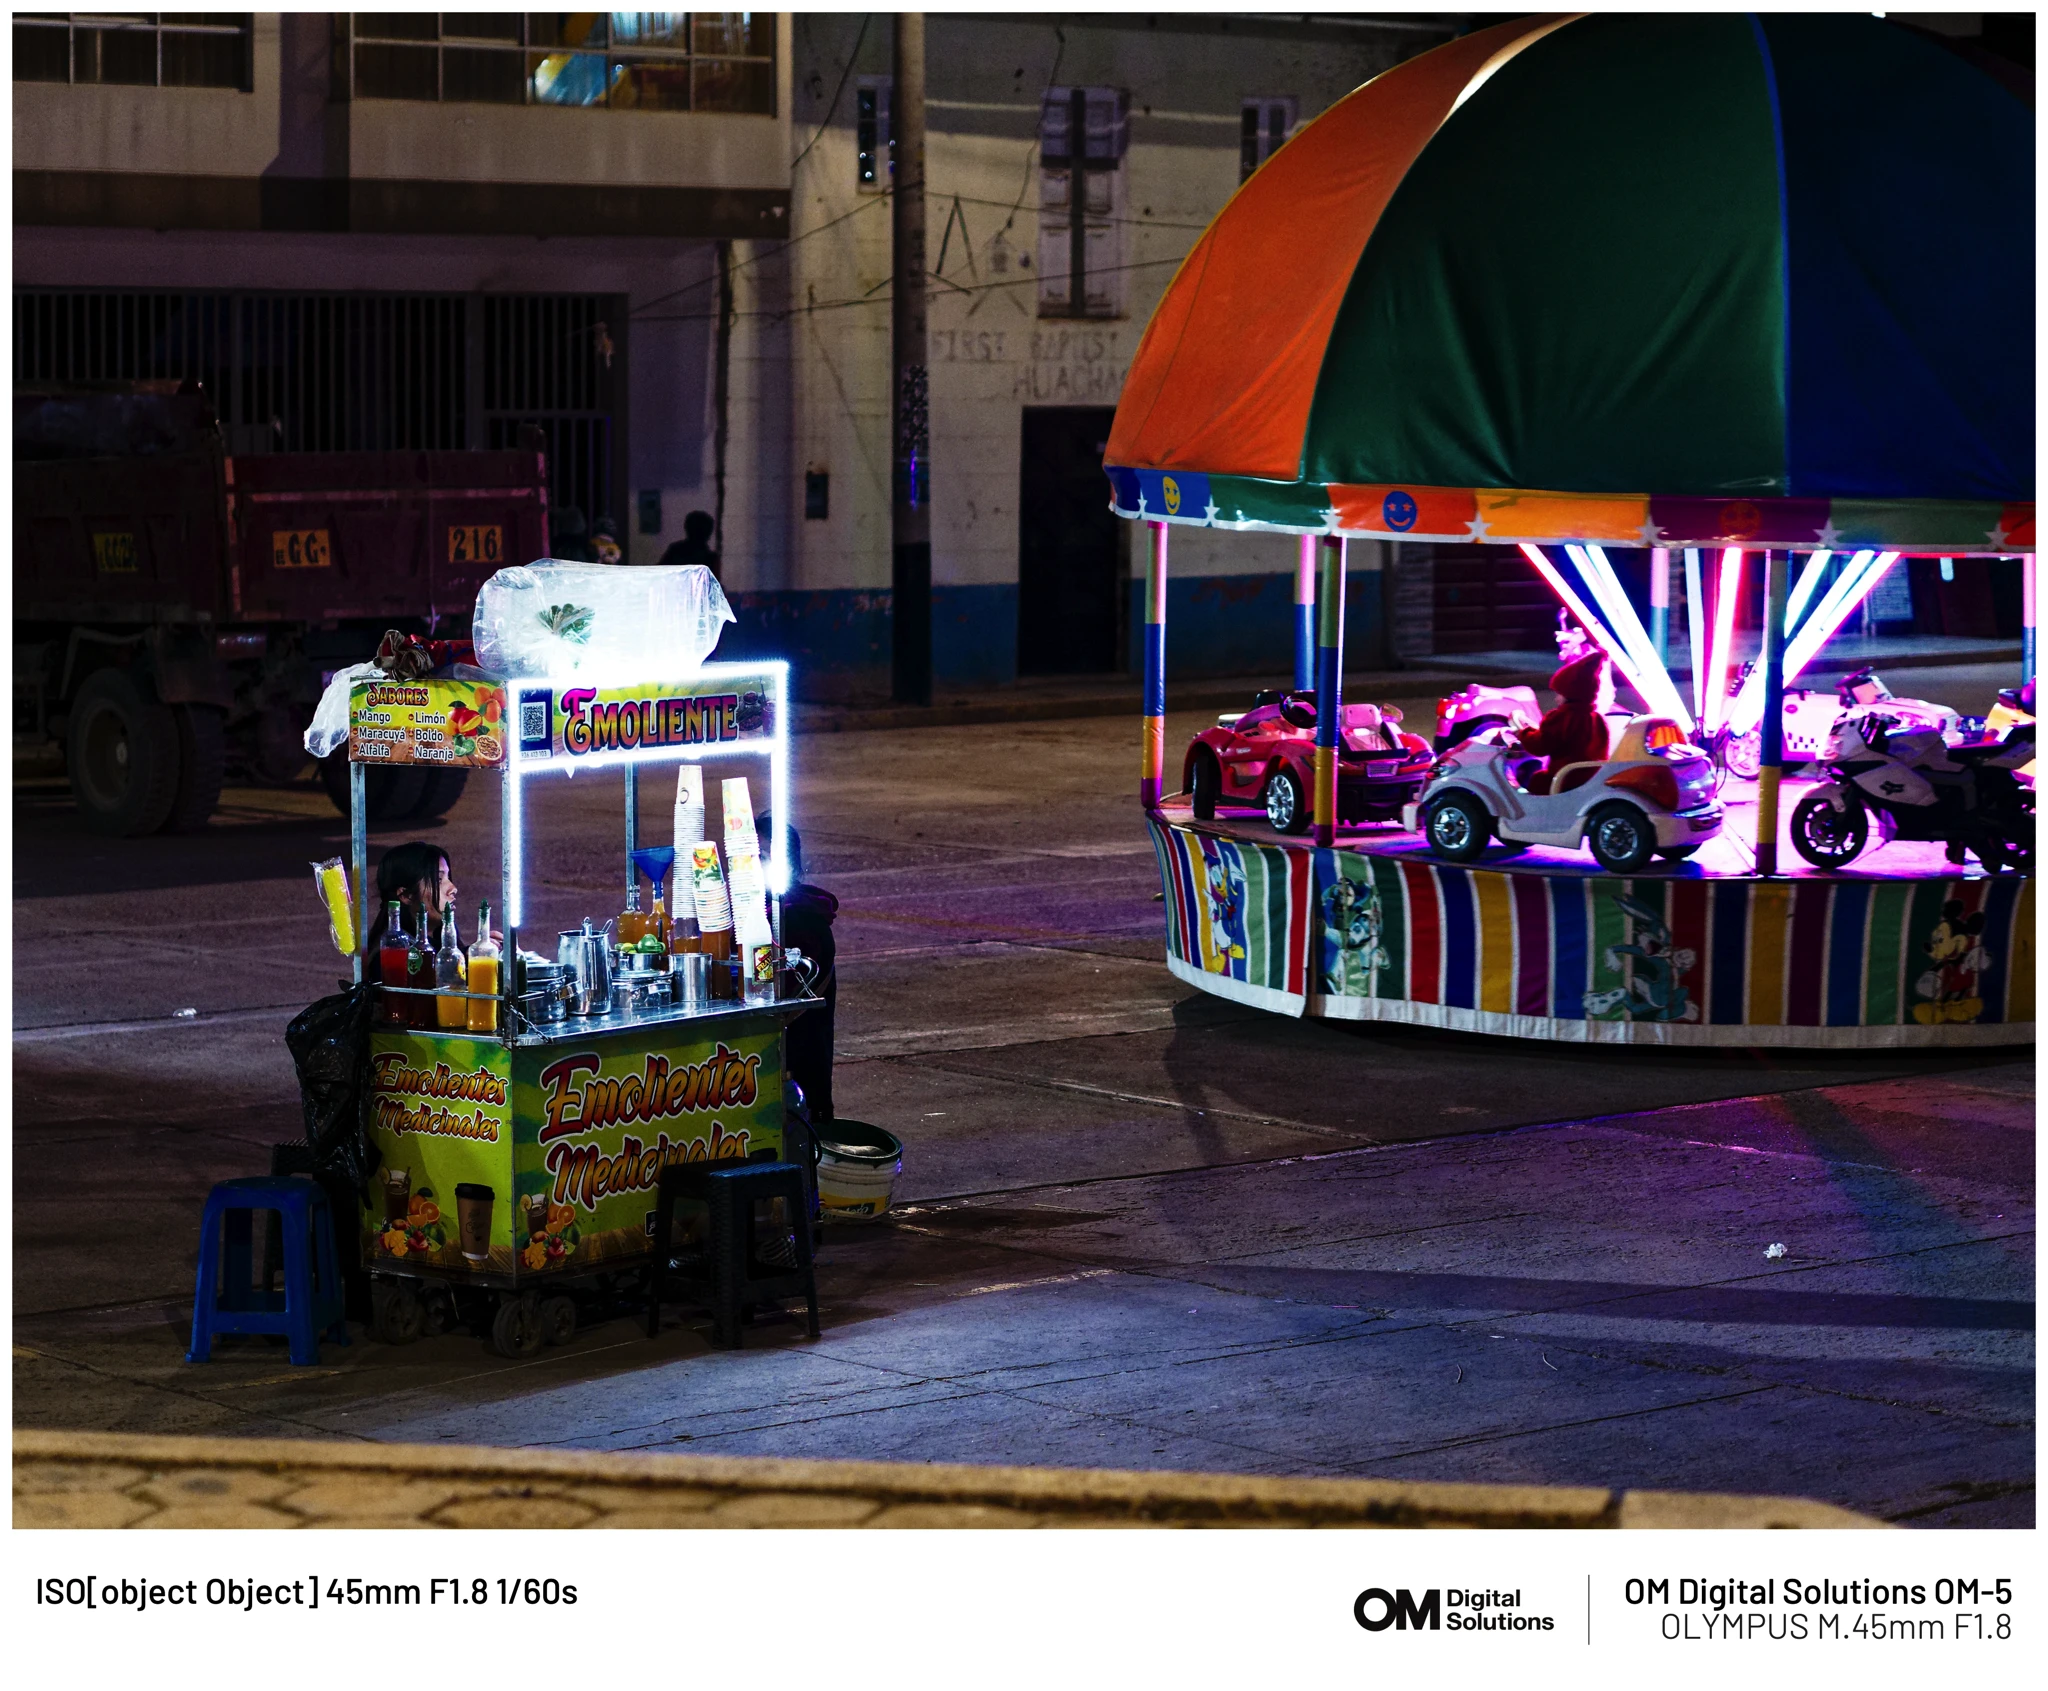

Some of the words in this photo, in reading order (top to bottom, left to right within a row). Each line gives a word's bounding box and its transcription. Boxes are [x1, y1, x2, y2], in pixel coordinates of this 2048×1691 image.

[453, 527, 497, 561] 216
[366, 682, 429, 707] SABORES
[358, 710, 391, 724] Mango
[415, 711, 446, 725] Limón
[561, 687, 739, 756] EMOLIENTE
[358, 726, 406, 742] Maracuyá
[415, 729, 443, 742] Boldo
[358, 744, 390, 757] Alfalfa
[414, 746, 454, 762] Naranja
[372, 1052, 508, 1107] Emolientes
[540, 1042, 761, 1145] Emolientes
[374, 1096, 500, 1143] Medicinales
